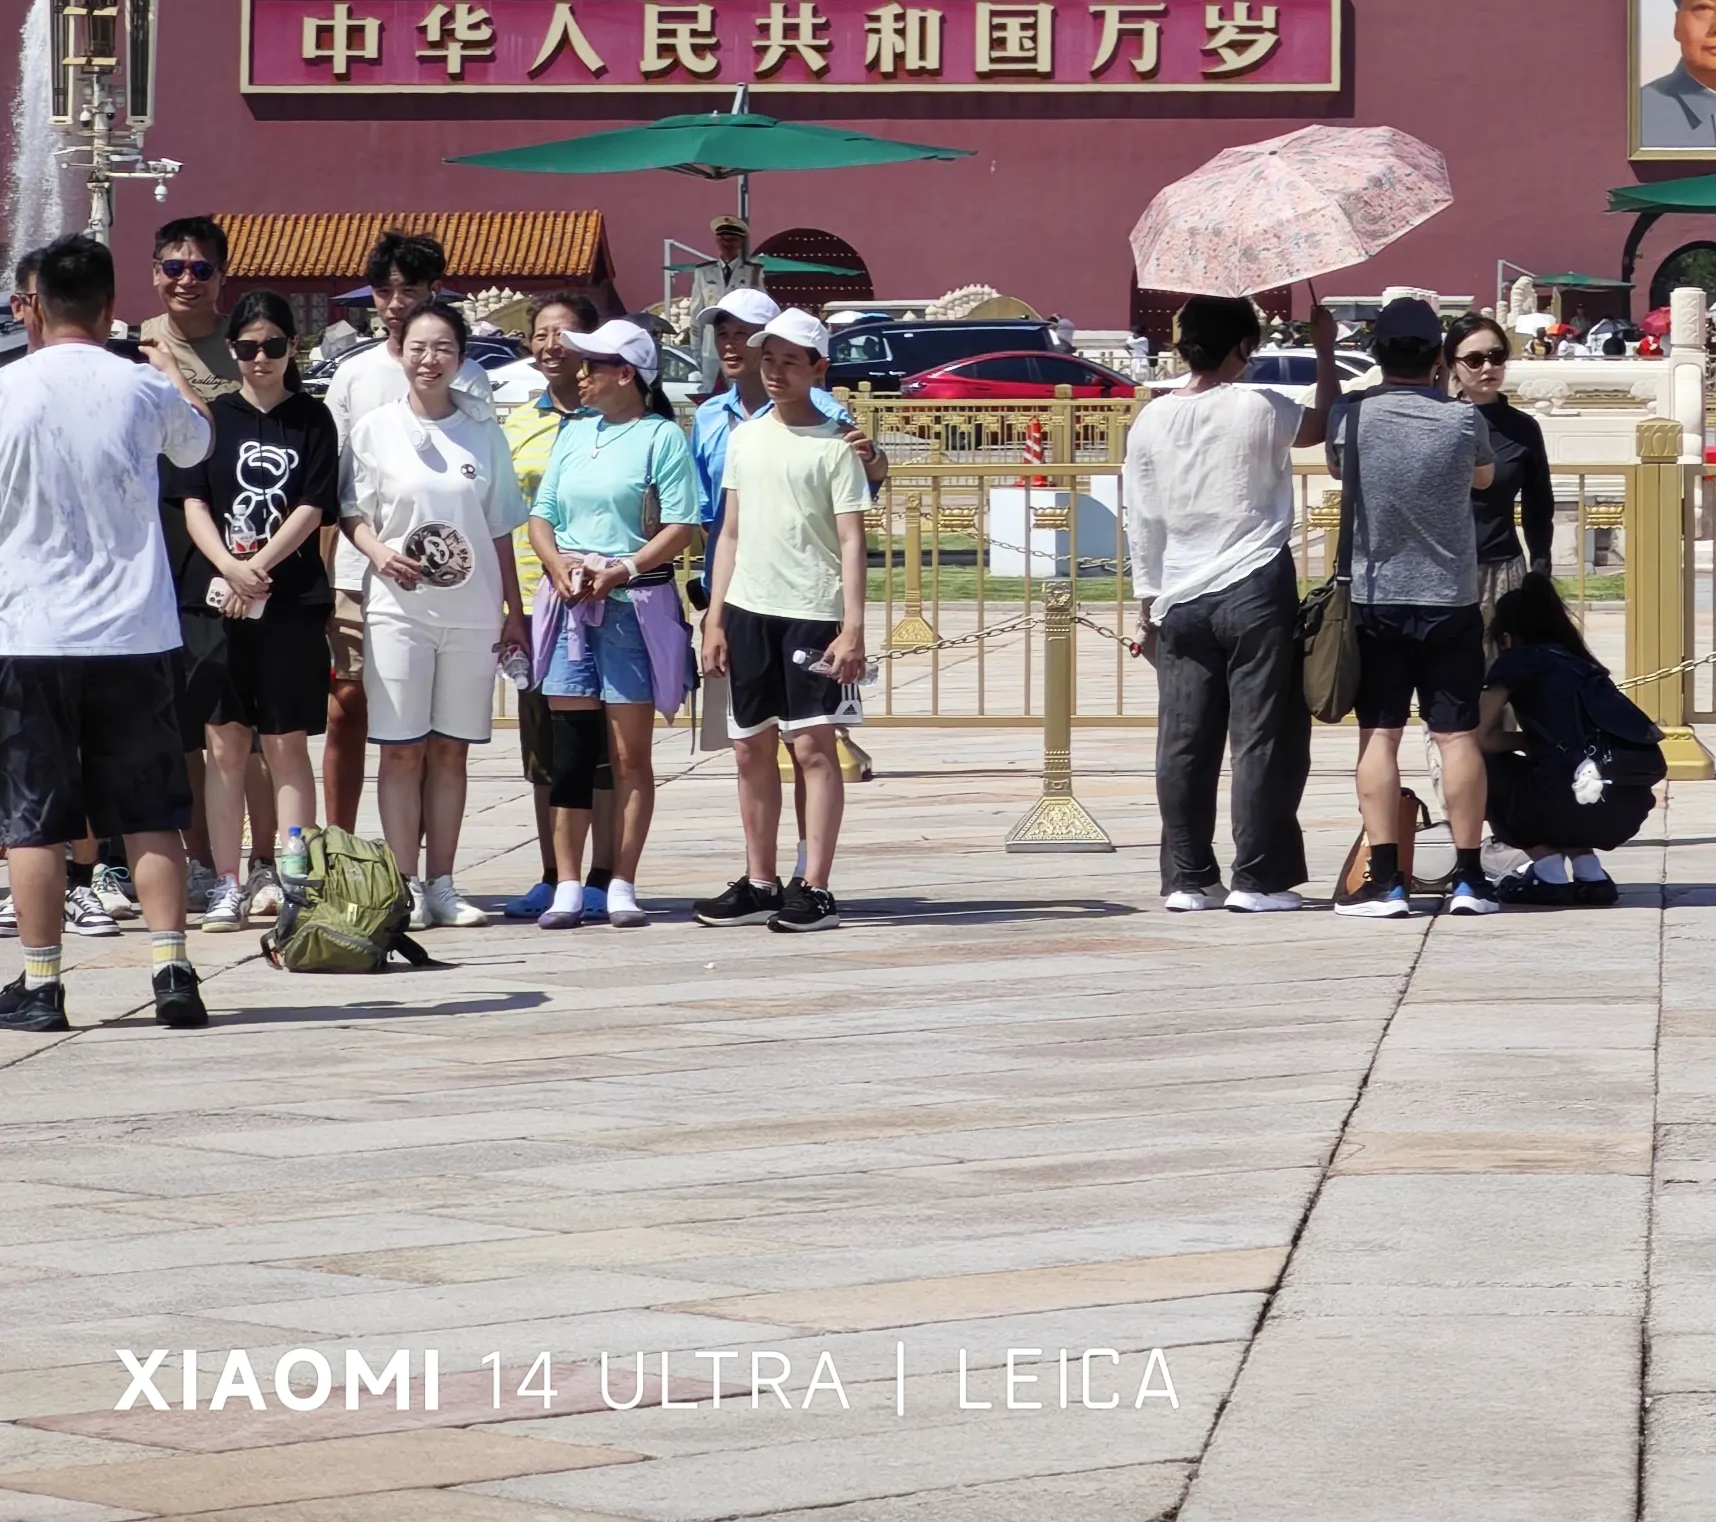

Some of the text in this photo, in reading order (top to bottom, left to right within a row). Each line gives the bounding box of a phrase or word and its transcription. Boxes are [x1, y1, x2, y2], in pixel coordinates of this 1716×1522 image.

[301, 1, 1281, 74] 中华人民共和国万岁
